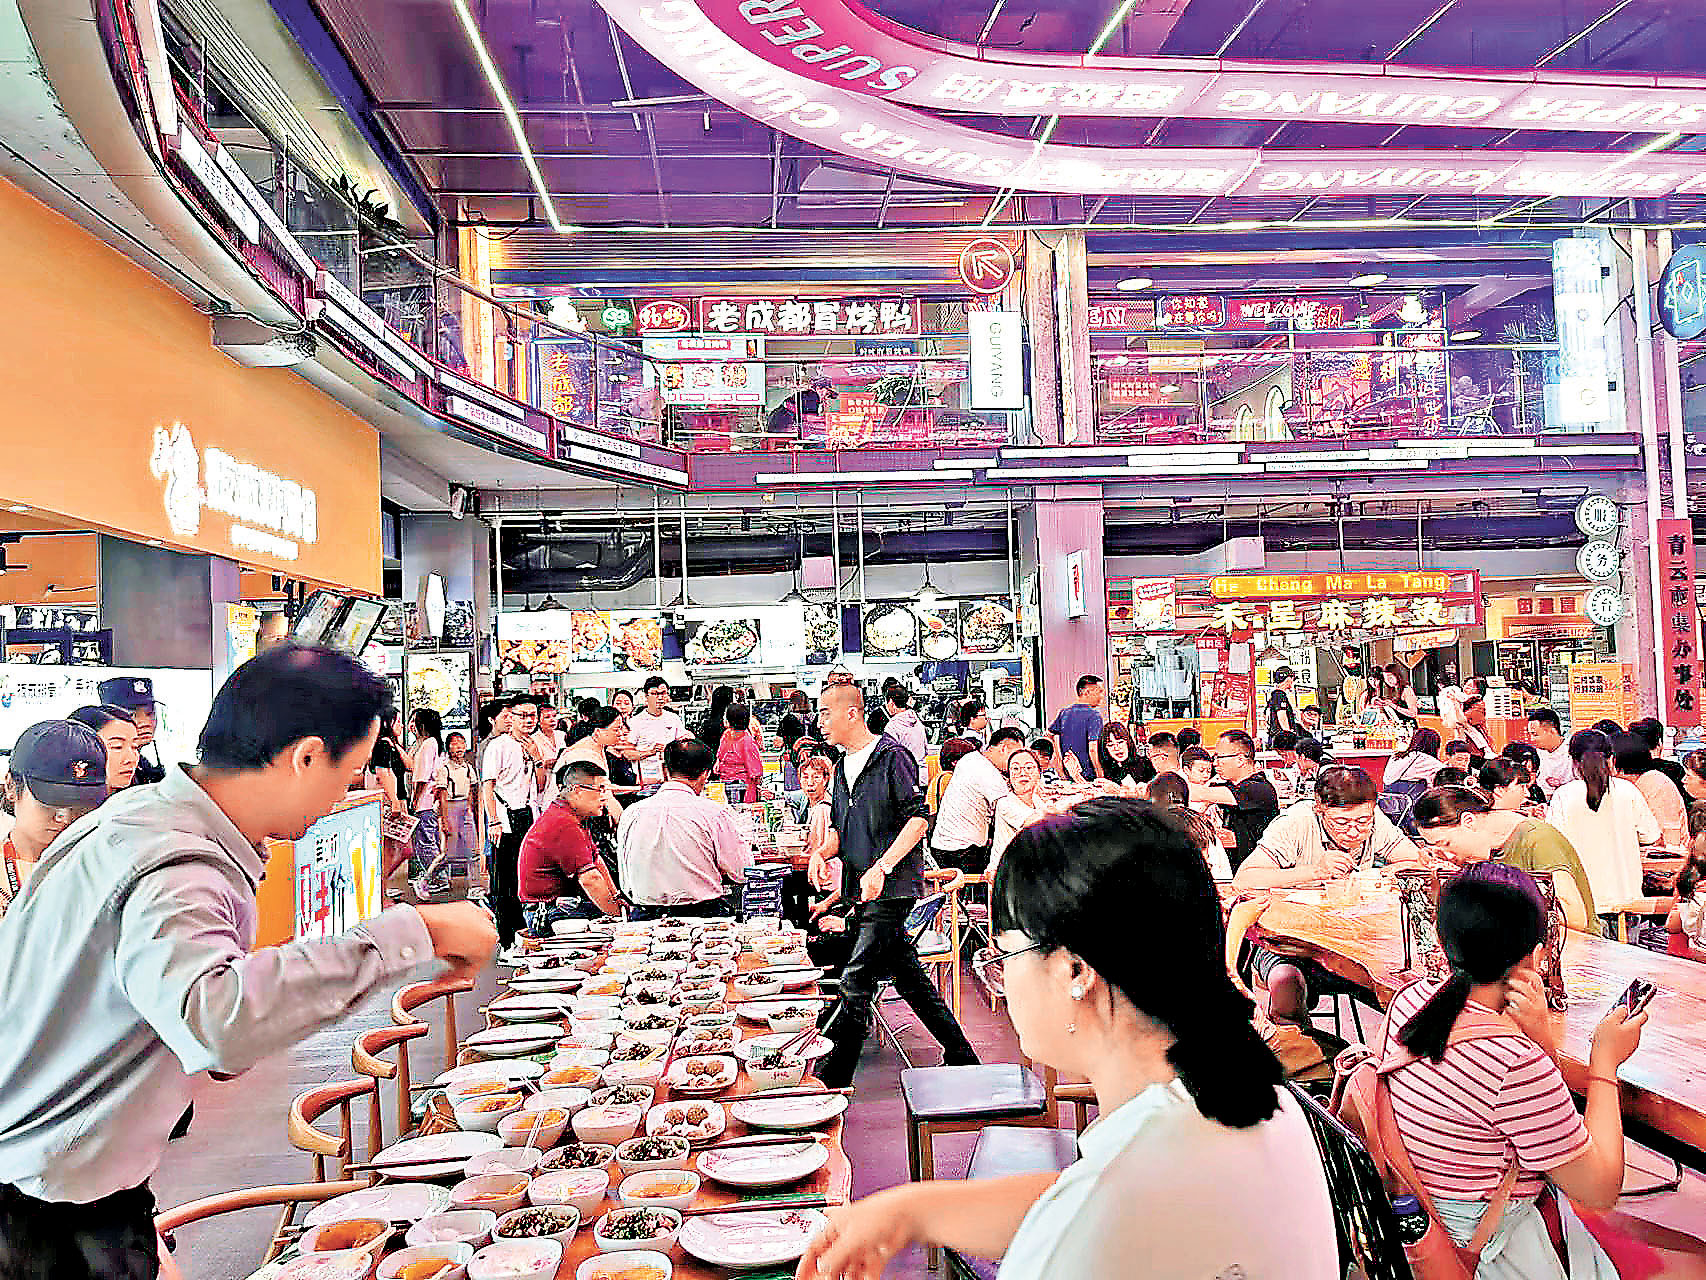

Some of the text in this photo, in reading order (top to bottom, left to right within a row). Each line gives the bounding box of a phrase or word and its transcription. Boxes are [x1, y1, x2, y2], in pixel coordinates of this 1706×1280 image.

[738, 0, 919, 91] SUPER
[1217, 89, 1706, 125] SUPER GUIYANG
[839, 121, 1012, 180] SUPER
[1035, 160, 1233, 189] 超级
[1258, 166, 1490, 191] GUIYANG
[709, 300, 913, 333] 老成都冒烤鸭
[989, 321, 1004, 398] GUIYANG
[1326, 575, 1353, 591] Ma
[1366, 575, 1387, 590] La
